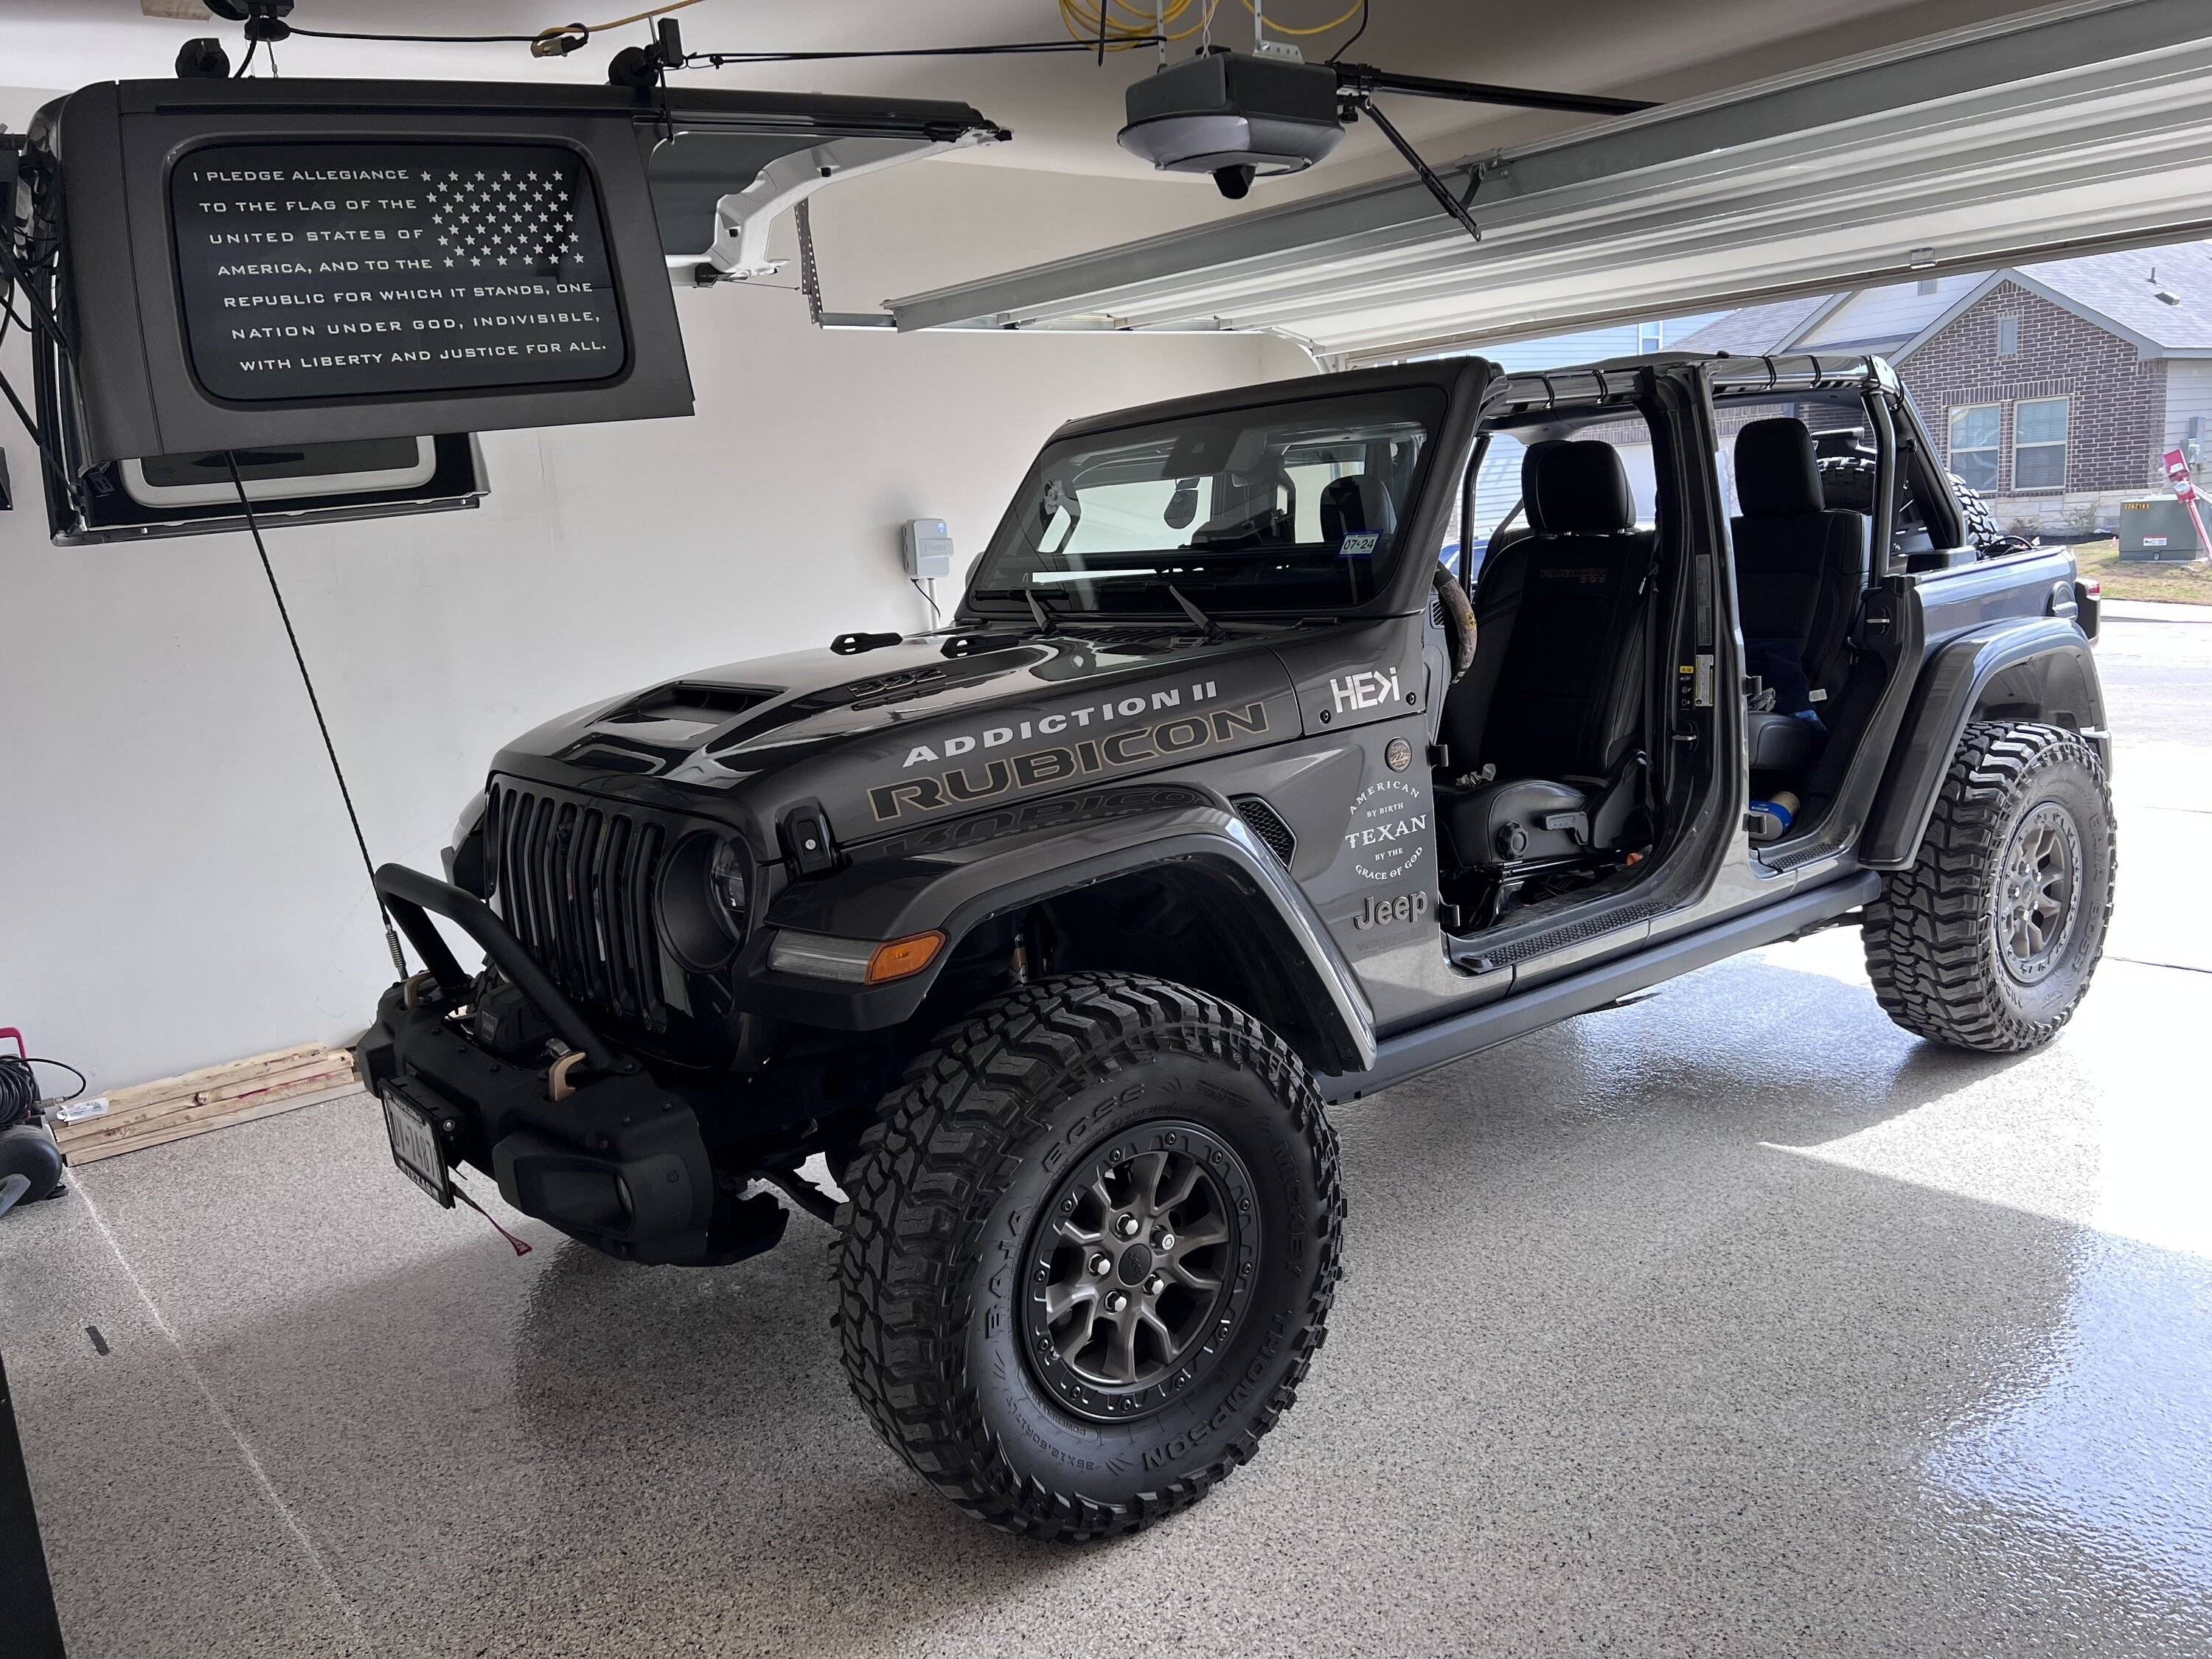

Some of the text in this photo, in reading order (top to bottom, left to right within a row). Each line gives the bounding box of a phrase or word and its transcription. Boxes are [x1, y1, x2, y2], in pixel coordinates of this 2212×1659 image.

[192, 170, 409, 181] I PLEDGE ALLEGIANCE
[199, 199, 417, 212] TO THE FLAG OF THE
[209, 229, 423, 244] UNITED STATES OF
[218, 259, 433, 276] AMERICA, AND TO THE
[223, 282, 593, 307] REPUBLIC FOR WHICH IT STANDS, ONE
[231, 311, 600, 340] NATION UNDER GOD, INDIVISIBLE,
[239, 341, 606, 372] WITH LIBERTY AND JUSTICE FOR ALL.
[901, 688, 1181, 768] ADDICTION
[866, 702, 1270, 823] RUBICON
[1349, 781, 1420, 815] AMERICAN
[1366, 802, 1404, 818] BY BIRTH
[1345, 814, 1427, 849] TEXAN
[1355, 846, 1423, 880] GRACE OF GOD
[1374, 847, 1404, 861] BY THE
[1354, 890, 1428, 931] Jeep
[1041, 1082, 1144, 1174] BOSS
[1143, 1310, 1293, 1471] THOMPSON
